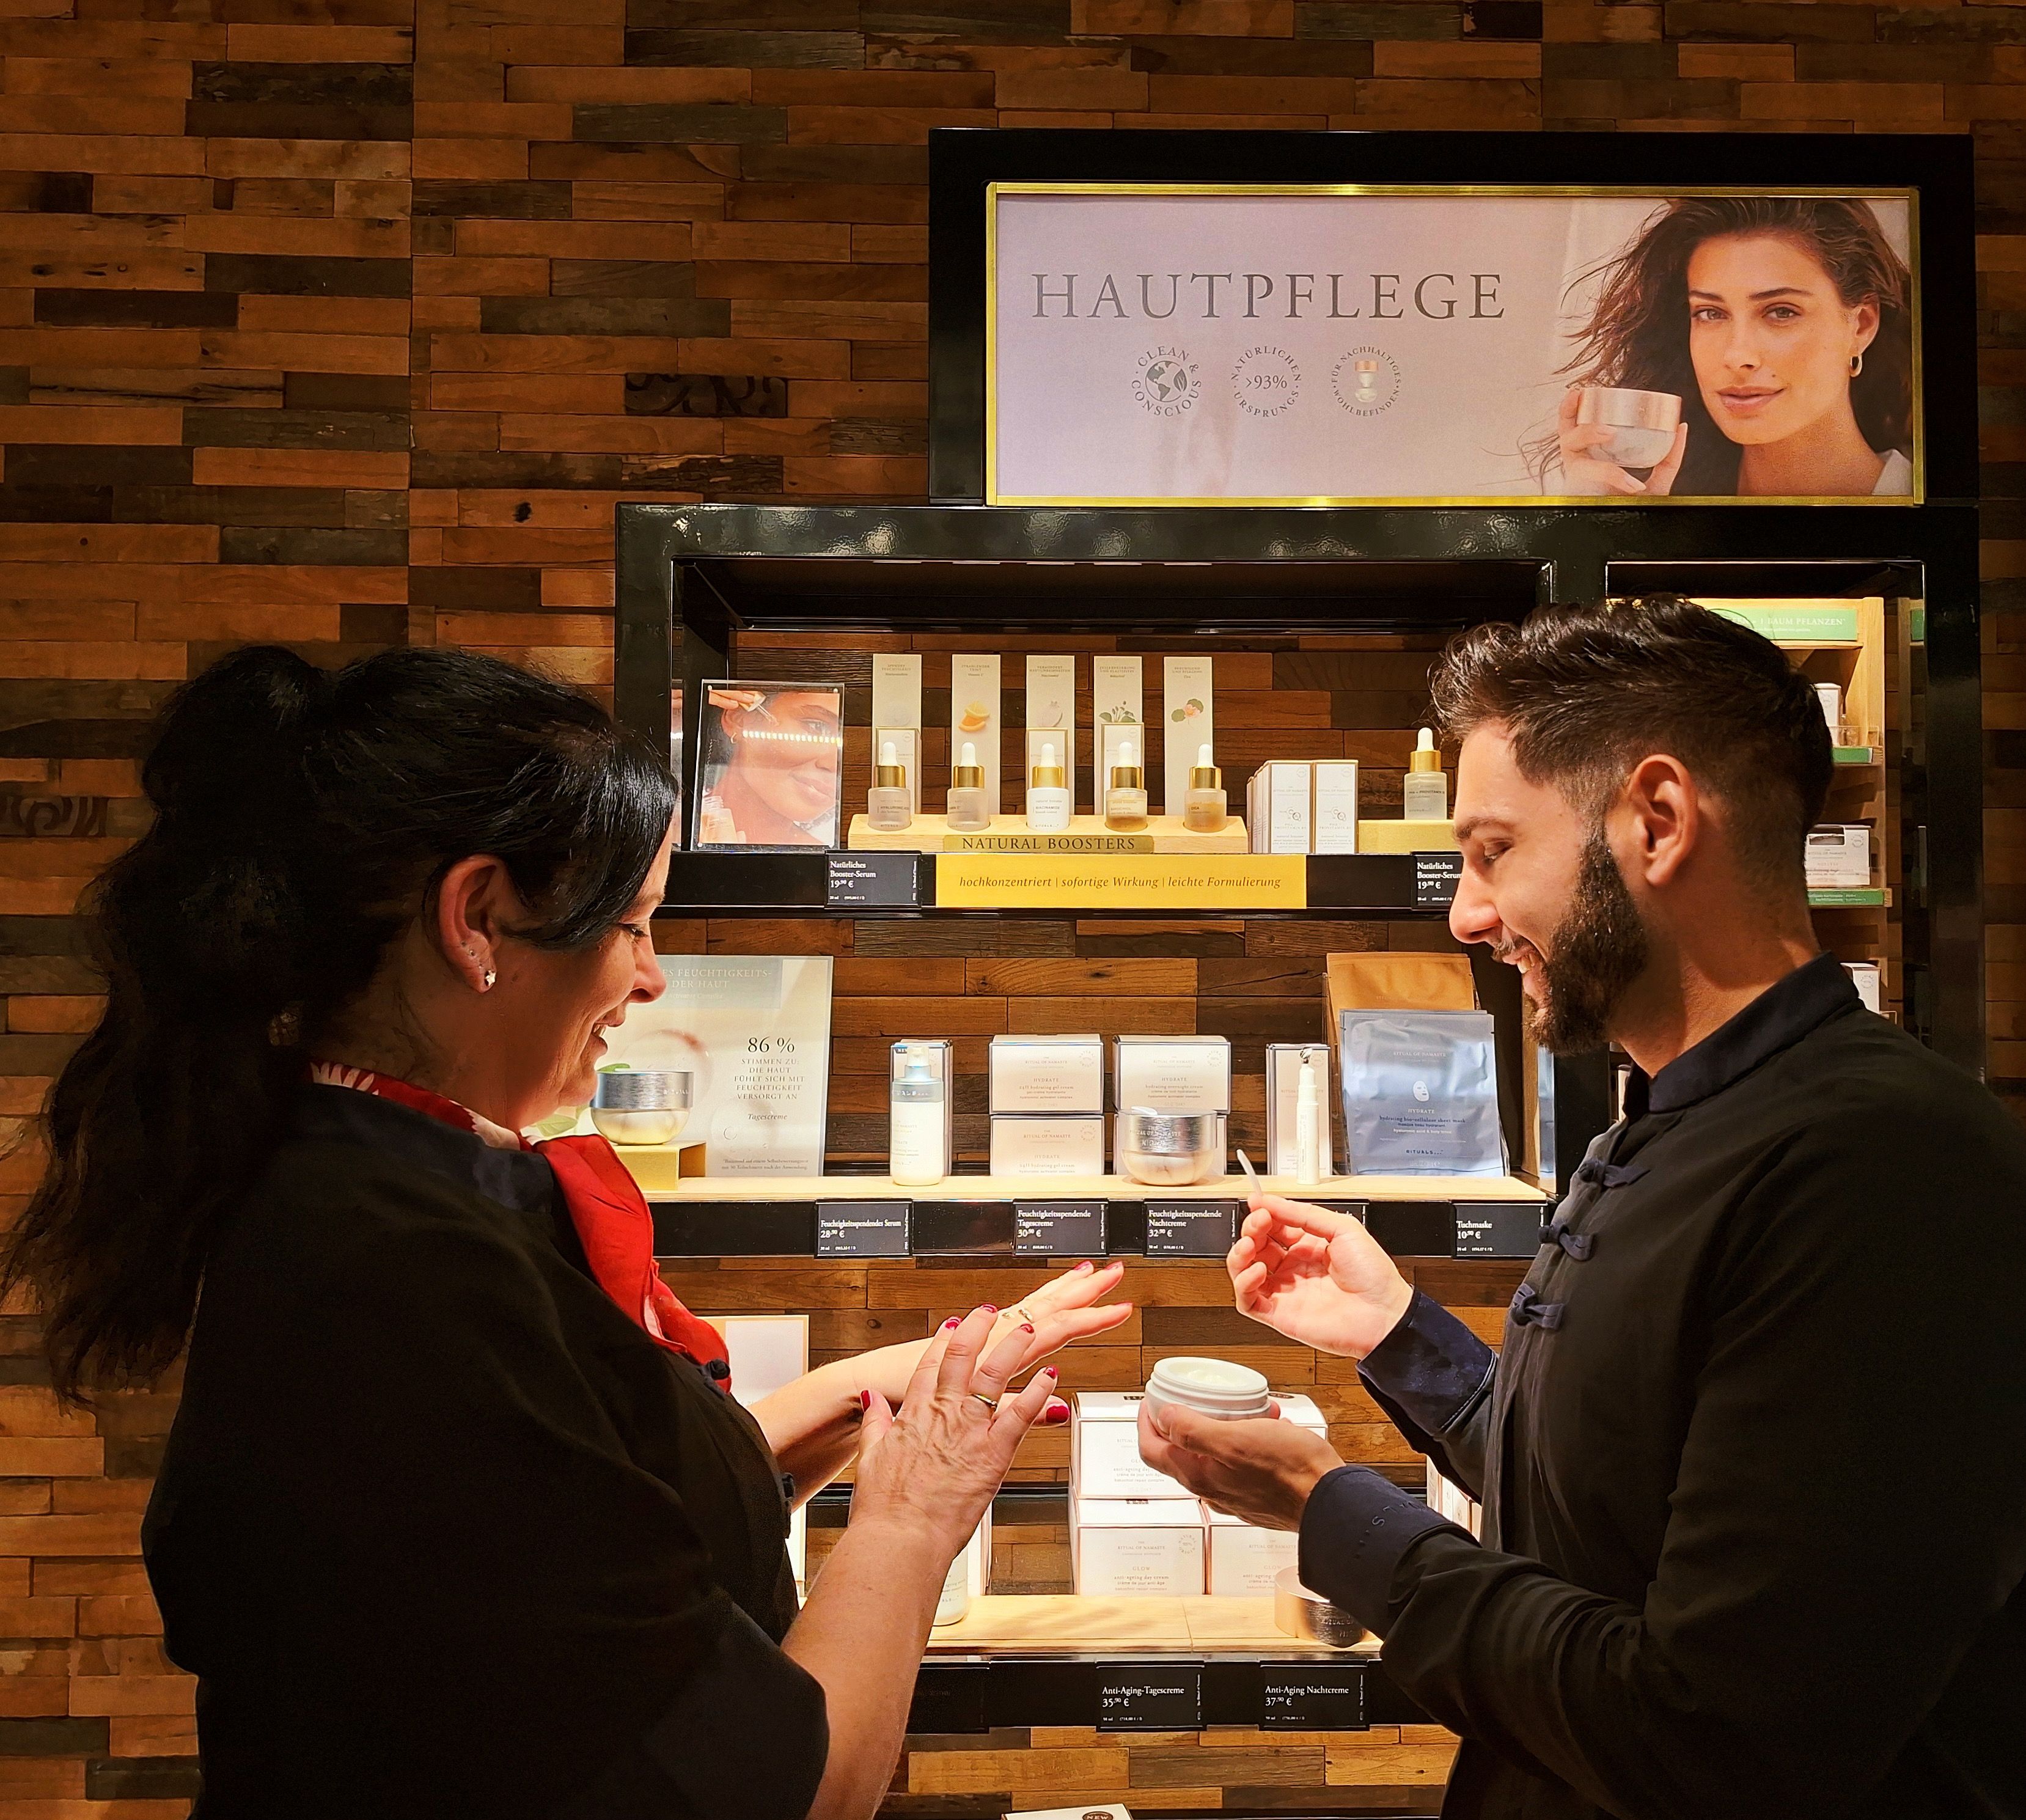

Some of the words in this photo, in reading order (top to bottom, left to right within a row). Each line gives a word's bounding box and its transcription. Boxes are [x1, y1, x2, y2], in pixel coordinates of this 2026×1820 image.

[1031, 273, 1505, 318] HAUTPFLEGE
[1137, 346, 1189, 367] CLEAN
[1189, 364, 1198, 373] &
[1231, 345, 1301, 381] NATÜRLICHEN
[1331, 364, 1342, 383] FÜR
[1340, 346, 1401, 384] NACHHALTIGES
[1246, 375, 1288, 390] >93%
[1131, 380, 1202, 417] CONSCIOUS
[1233, 390, 1299, 417] URSPRUNGS
[1333, 389, 1400, 417] WOHLBEFINDEN
[963, 838, 1041, 849] NATURAL
[1048, 838, 1135, 849] BOOSTERS
[960, 876, 1052, 887] hochkonzentriert
[1061, 876, 1109, 889] sofortige
[1113, 876, 1159, 889] Wirkung
[1168, 876, 1203, 887] leichte
[1207, 876, 1282, 889] Formulierung
[747, 1036, 770, 1053] 86
[777, 1037, 795, 1053] %
[1017, 1209, 1092, 1219] Feuchtigkeitsspendende
[1148, 1209, 1222, 1219] Feuchtigkeitsspendende
[1017, 1219, 1054, 1228] Tagescreme
[1456, 1220, 1492, 1229] Tuchmaske
[839, 1230, 845, 1238] €
[1167, 1229, 1173, 1238] €
[1475, 1231, 1481, 1239] €
[1102, 1686, 1184, 1696] Anti-Aging-Tagescreme
[1265, 1686, 1305, 1695] Anti-Aging
[1307, 1685, 1349, 1693] Nachtcreme
[1123, 1698, 1129, 1707] €
[1286, 1697, 1292, 1706] €
